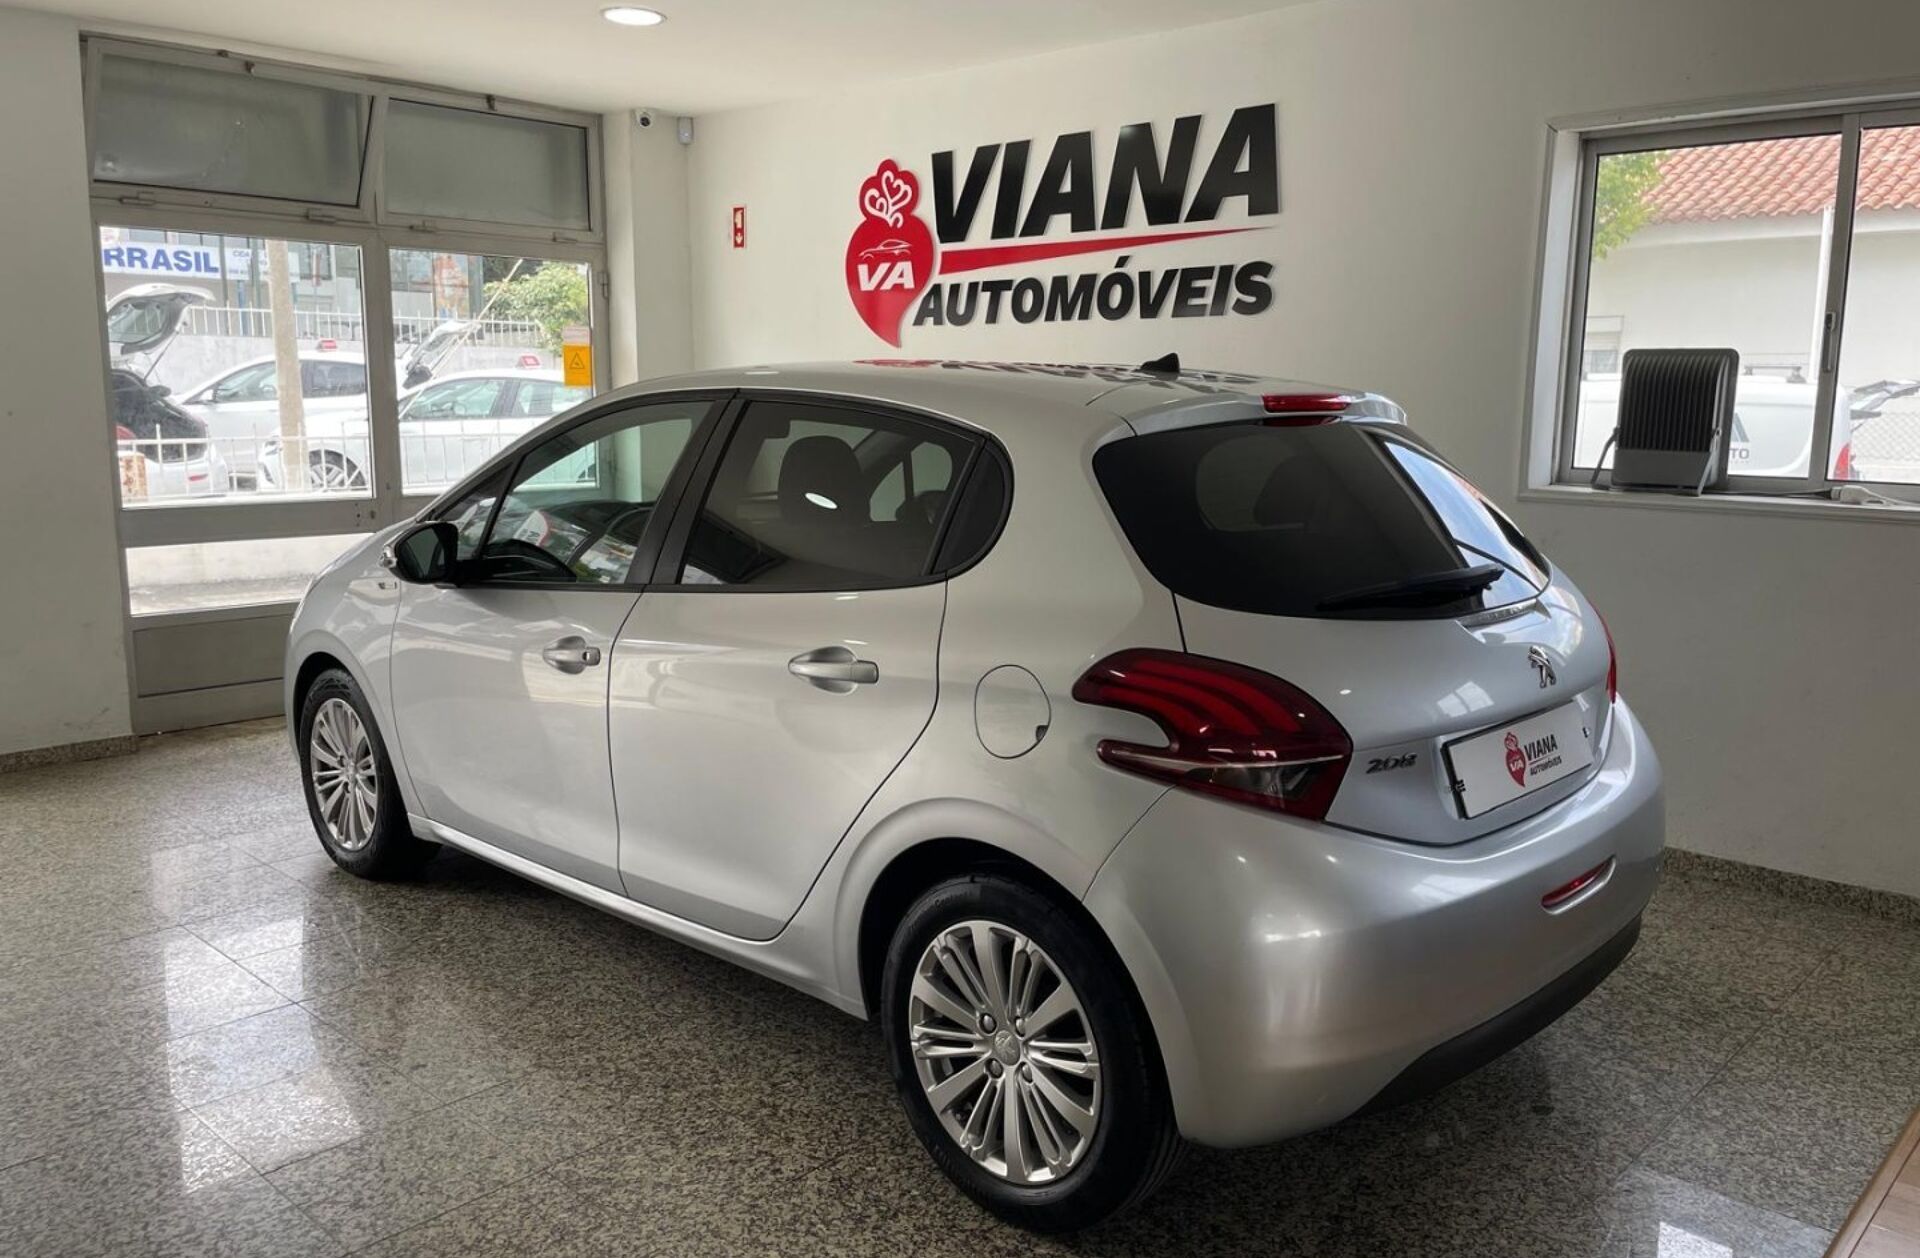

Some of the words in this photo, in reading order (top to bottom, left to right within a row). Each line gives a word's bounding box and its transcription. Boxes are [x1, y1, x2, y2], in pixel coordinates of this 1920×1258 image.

[931, 102, 1281, 244] VIANA
[103, 246, 220, 274] RRASIL
[857, 260, 915, 292] VA
[912, 256, 1274, 327] AUTOMÓVEIS
[1524, 734, 1558, 761] VIANA
[1366, 752, 1418, 774] 208
